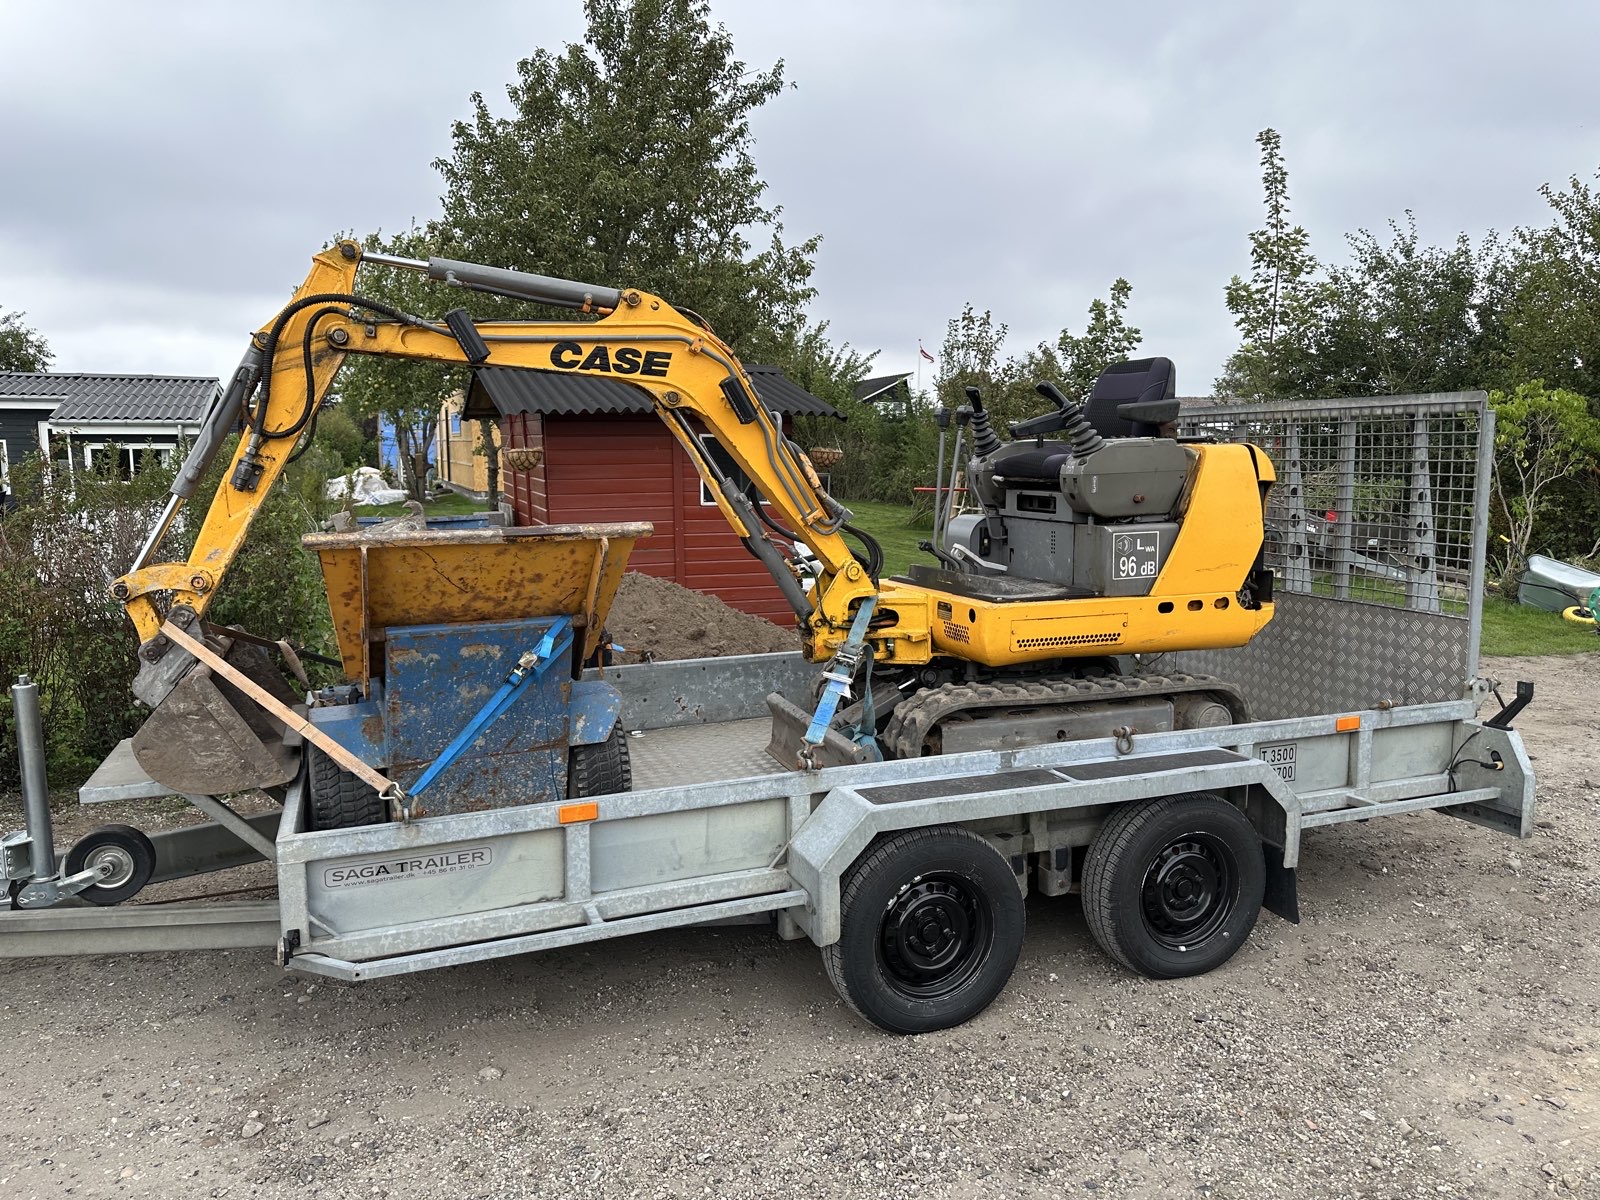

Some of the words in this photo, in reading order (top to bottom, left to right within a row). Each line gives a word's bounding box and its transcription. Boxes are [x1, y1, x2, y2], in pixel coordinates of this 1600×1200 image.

[550, 341, 672, 377] CASE
[1120, 556, 1137, 577] 96
[1140, 561, 1156, 576] dB
[332, 864, 390, 882] SAGA
[396, 851, 485, 873] TRAILER
[344, 872, 416, 887] www.sagatrailer.dk
